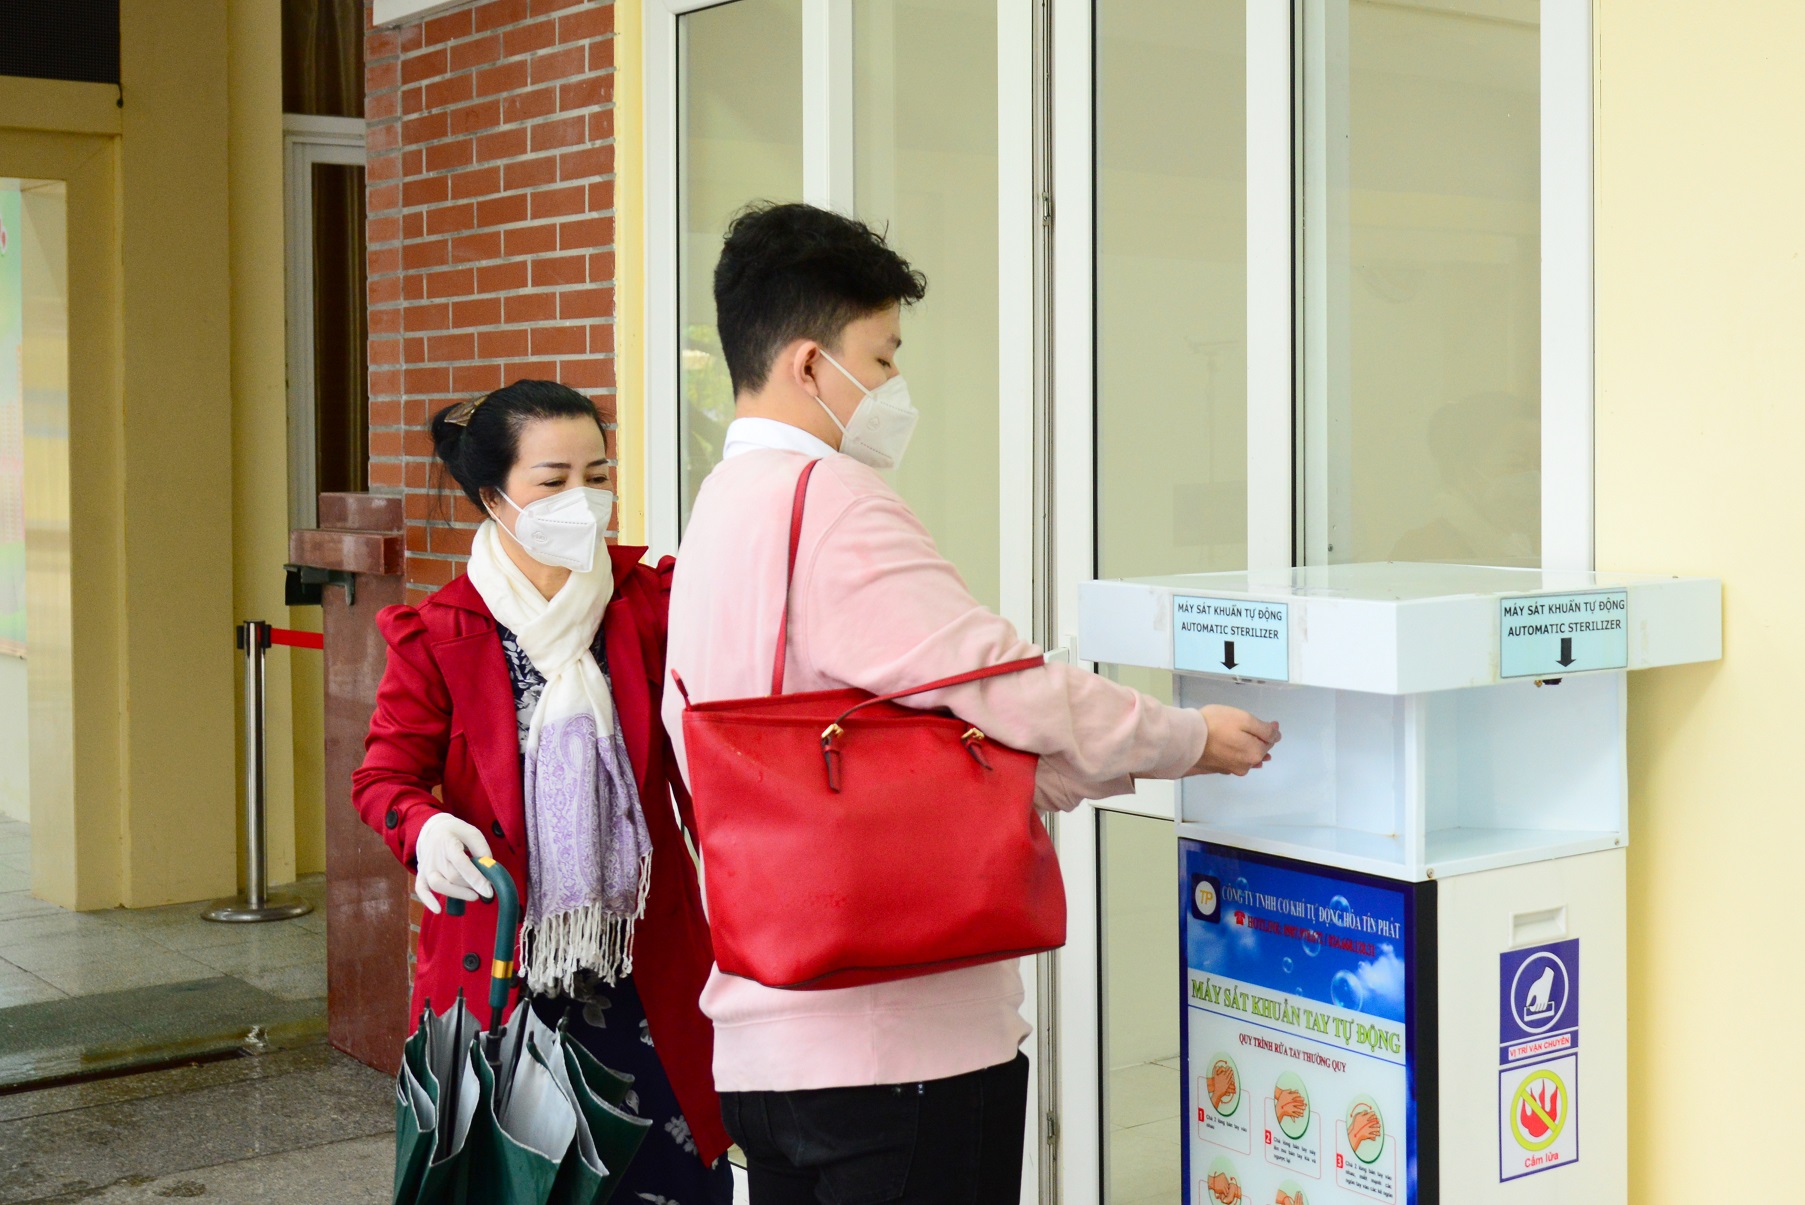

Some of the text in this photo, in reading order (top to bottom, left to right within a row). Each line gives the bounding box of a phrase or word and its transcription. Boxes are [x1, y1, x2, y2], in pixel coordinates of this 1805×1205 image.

[1177, 600, 1194, 613] MÁY
[1196, 602, 1212, 615] SÁT
[1244, 608, 1256, 621] TỰ
[1257, 607, 1283, 622] ĐỘNG
[1503, 602, 1525, 617] MÁY
[1527, 601, 1546, 616] SÁT
[1583, 600, 1596, 614] TỰ
[1598, 597, 1625, 613] ĐỘNG
[1181, 621, 1279, 639] AUTOMATIC STERILIZER
[1507, 619, 1621, 637] AUTOMATIC STERILIZER
[1200, 889, 1213, 905] TP
[1222, 882, 1243, 904] CÔNG
[1244, 889, 1253, 906] TY
[1255, 892, 1276, 911] TNHH
[1290, 897, 1305, 918] KHÍ
[1318, 905, 1341, 927] ĐỘNG
[1377, 916, 1400, 939] PHÁT
[1191, 977, 1222, 1004] MÁY
[1223, 985, 1250, 1012] SÁT
[1303, 1009, 1331, 1034] TAY
[1332, 1017, 1355, 1045] TỰ
[1356, 1023, 1401, 1053] ĐỘNG
[1238, 1032, 1252, 1045] QUY
[1253, 1036, 1273, 1051] TRÌNH
[1288, 1046, 1301, 1059] TAY
[1331, 1058, 1346, 1073] QUY
[1517, 1045, 1528, 1055] TRÍ
[1266, 1133, 1270, 1143] 2
[1337, 1156, 1342, 1167] 3
